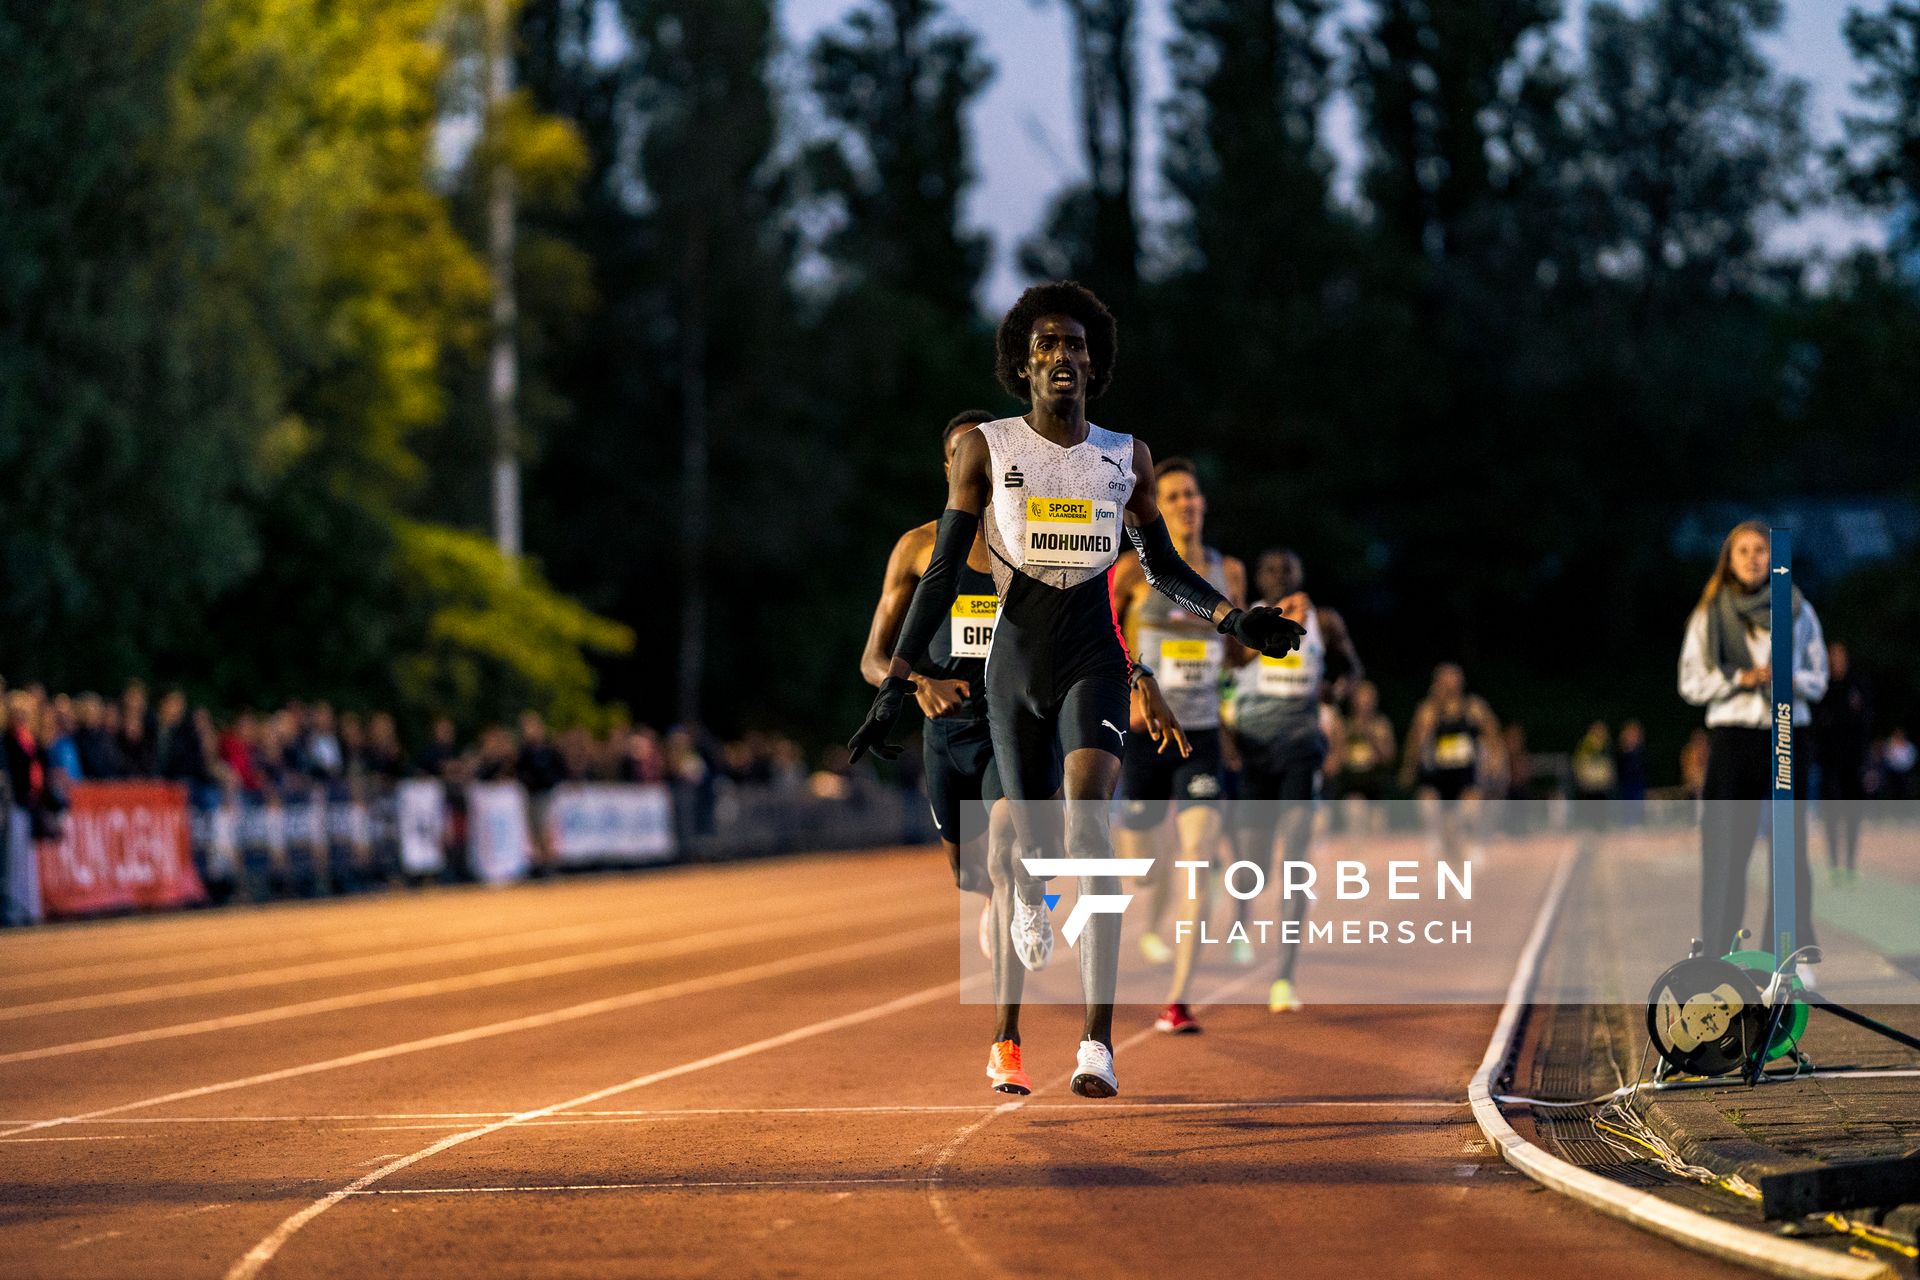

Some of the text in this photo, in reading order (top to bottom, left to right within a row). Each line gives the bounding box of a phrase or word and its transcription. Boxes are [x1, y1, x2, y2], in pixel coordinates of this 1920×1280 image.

[1048, 503, 1087, 514] SPORT.
[1095, 508, 1115, 521] ifam
[1031, 532, 1112, 553] MOHUMED
[1775, 702, 1792, 791] TimeTronics
